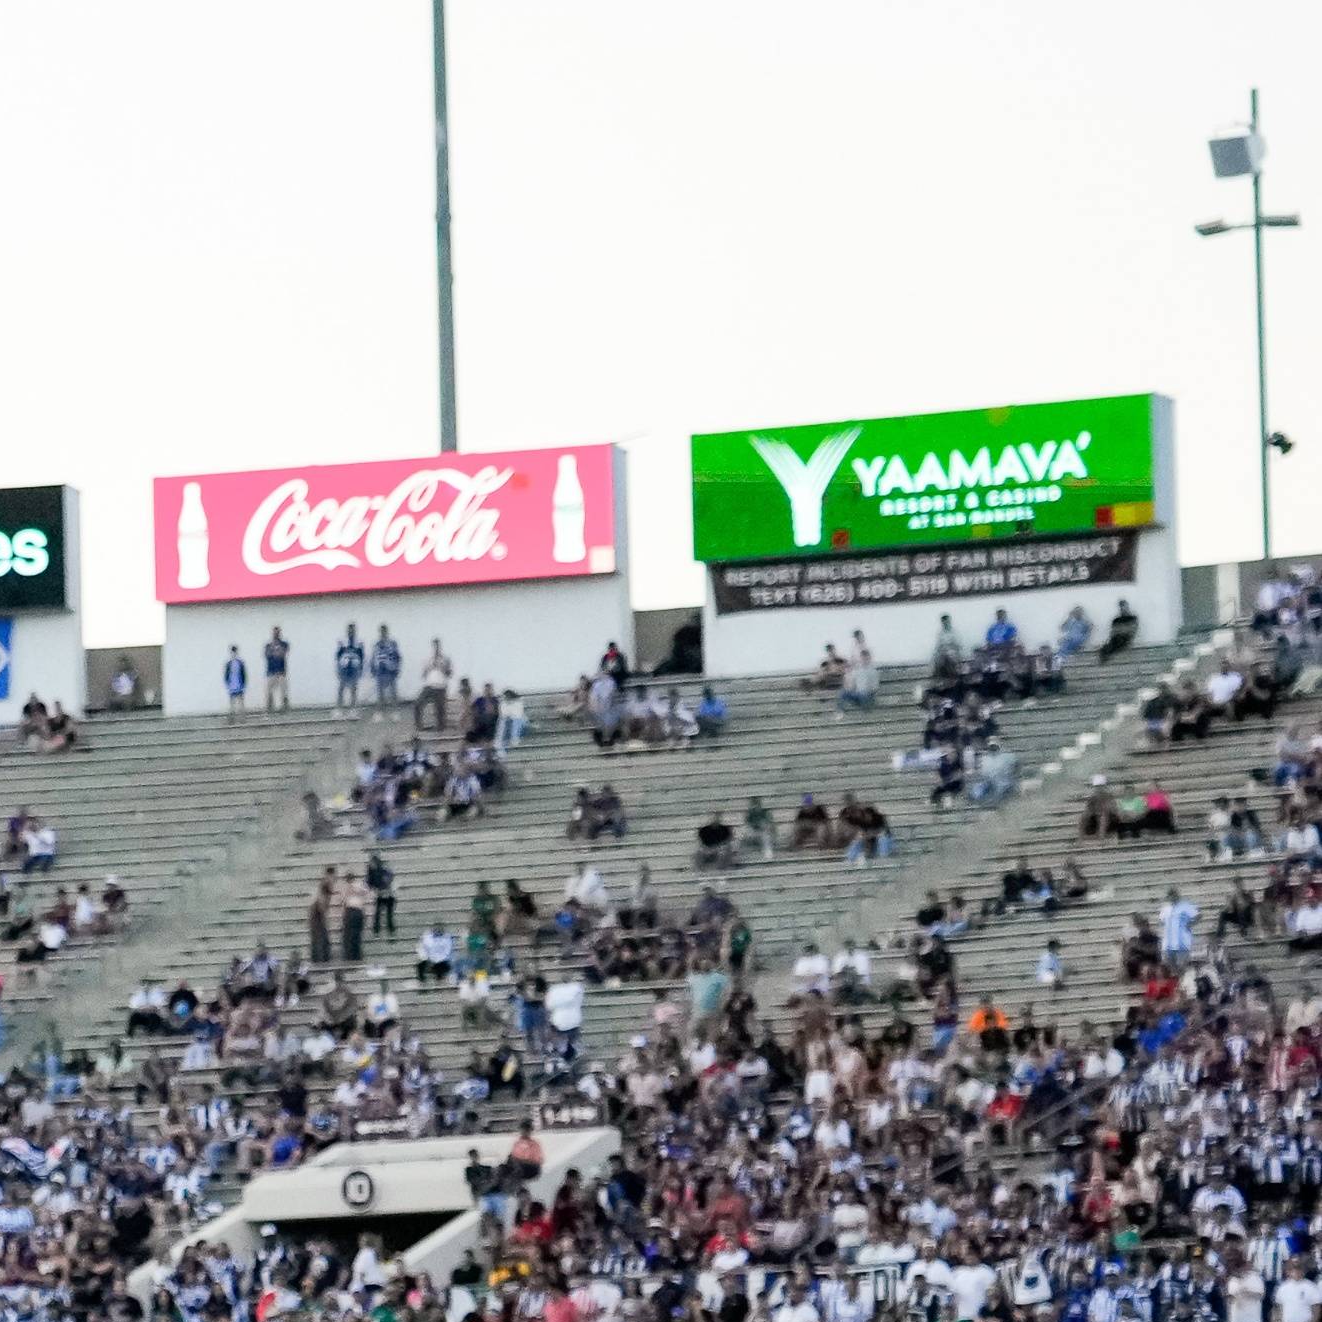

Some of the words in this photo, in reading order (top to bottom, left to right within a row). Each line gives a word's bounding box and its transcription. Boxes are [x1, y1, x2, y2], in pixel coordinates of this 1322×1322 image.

[879, 494, 958, 517] RESORT
[986, 484, 1062, 507] CASINO
[724, 564, 802, 588] REPORT
[806, 556, 909, 583] INCIDENTS
[911, 552, 942, 574] OF
[946, 549, 988, 570] FAN
[991, 537, 1123, 567] MISCONDUCT
[953, 570, 1005, 592] WITH
[1008, 561, 1091, 588] DETAILS
